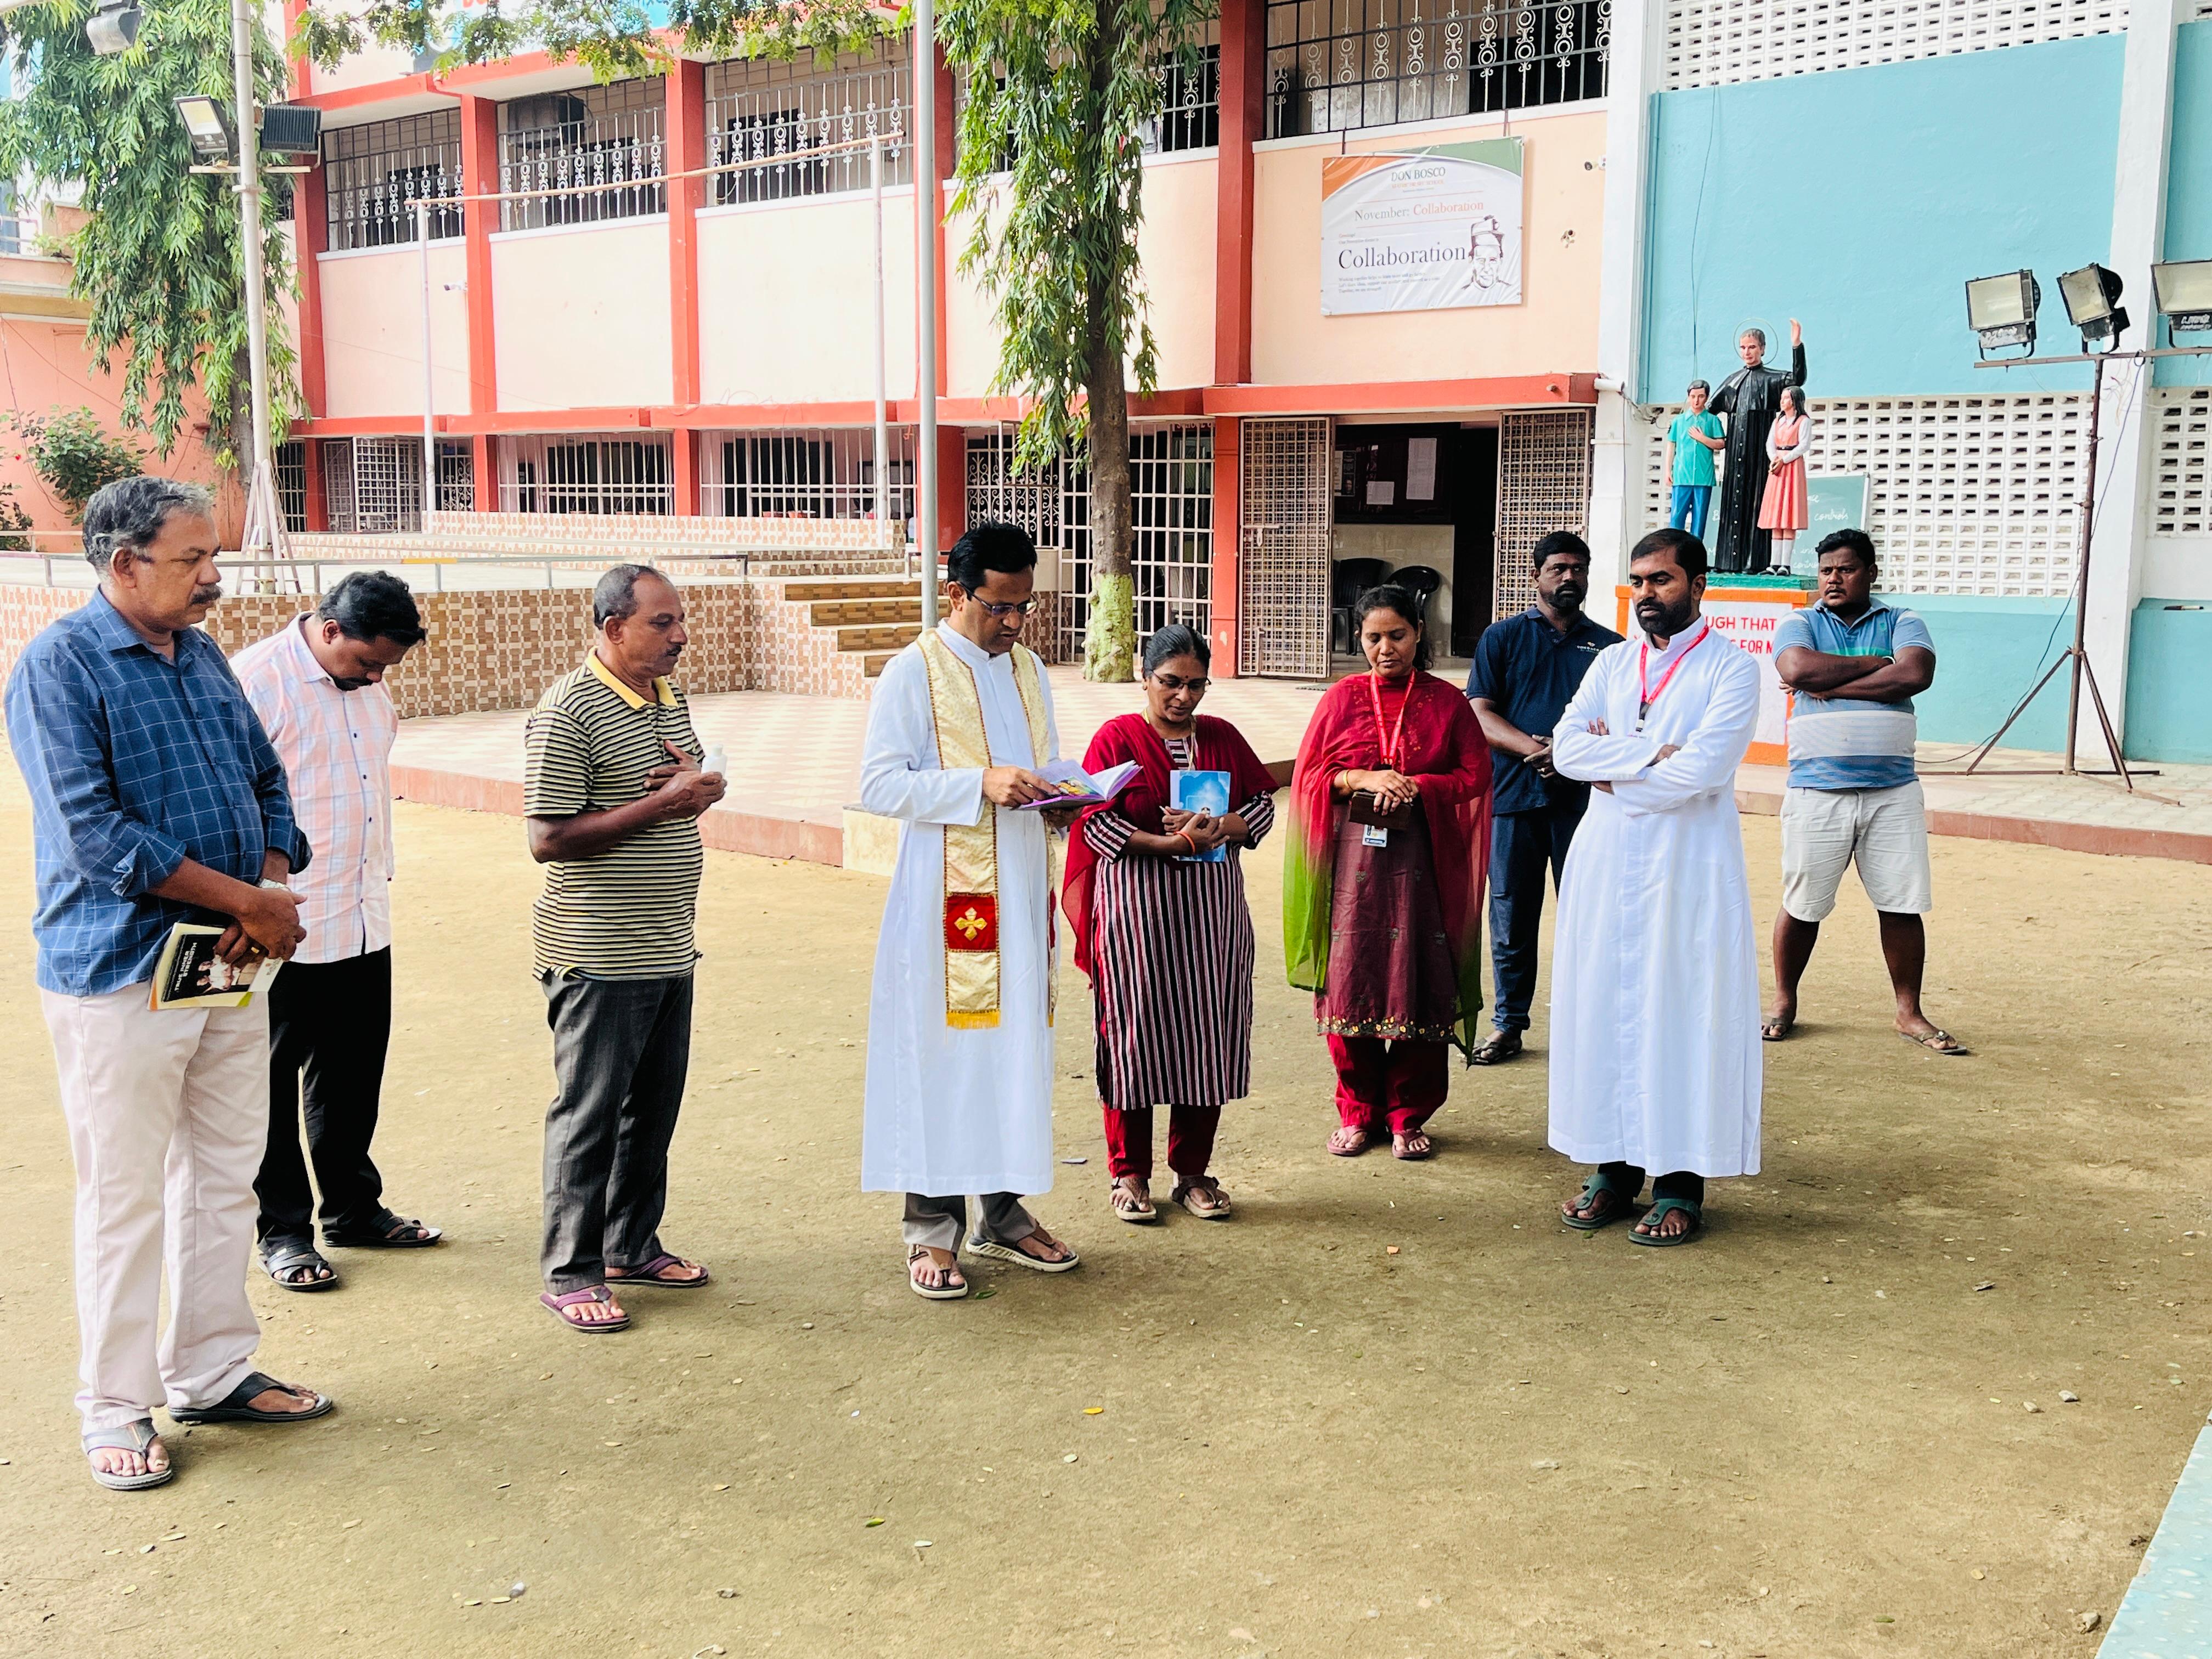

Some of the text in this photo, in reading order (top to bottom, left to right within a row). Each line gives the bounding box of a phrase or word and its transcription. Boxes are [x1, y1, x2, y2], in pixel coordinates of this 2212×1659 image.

[1391, 167, 1446, 182] DON BOSCO
[1355, 201, 1484, 221] November: Collaboration
[1339, 242, 1466, 268] Collaboration
[1706, 616, 1777, 631] UGH THAT
[1740, 639, 1763, 654] FOR
